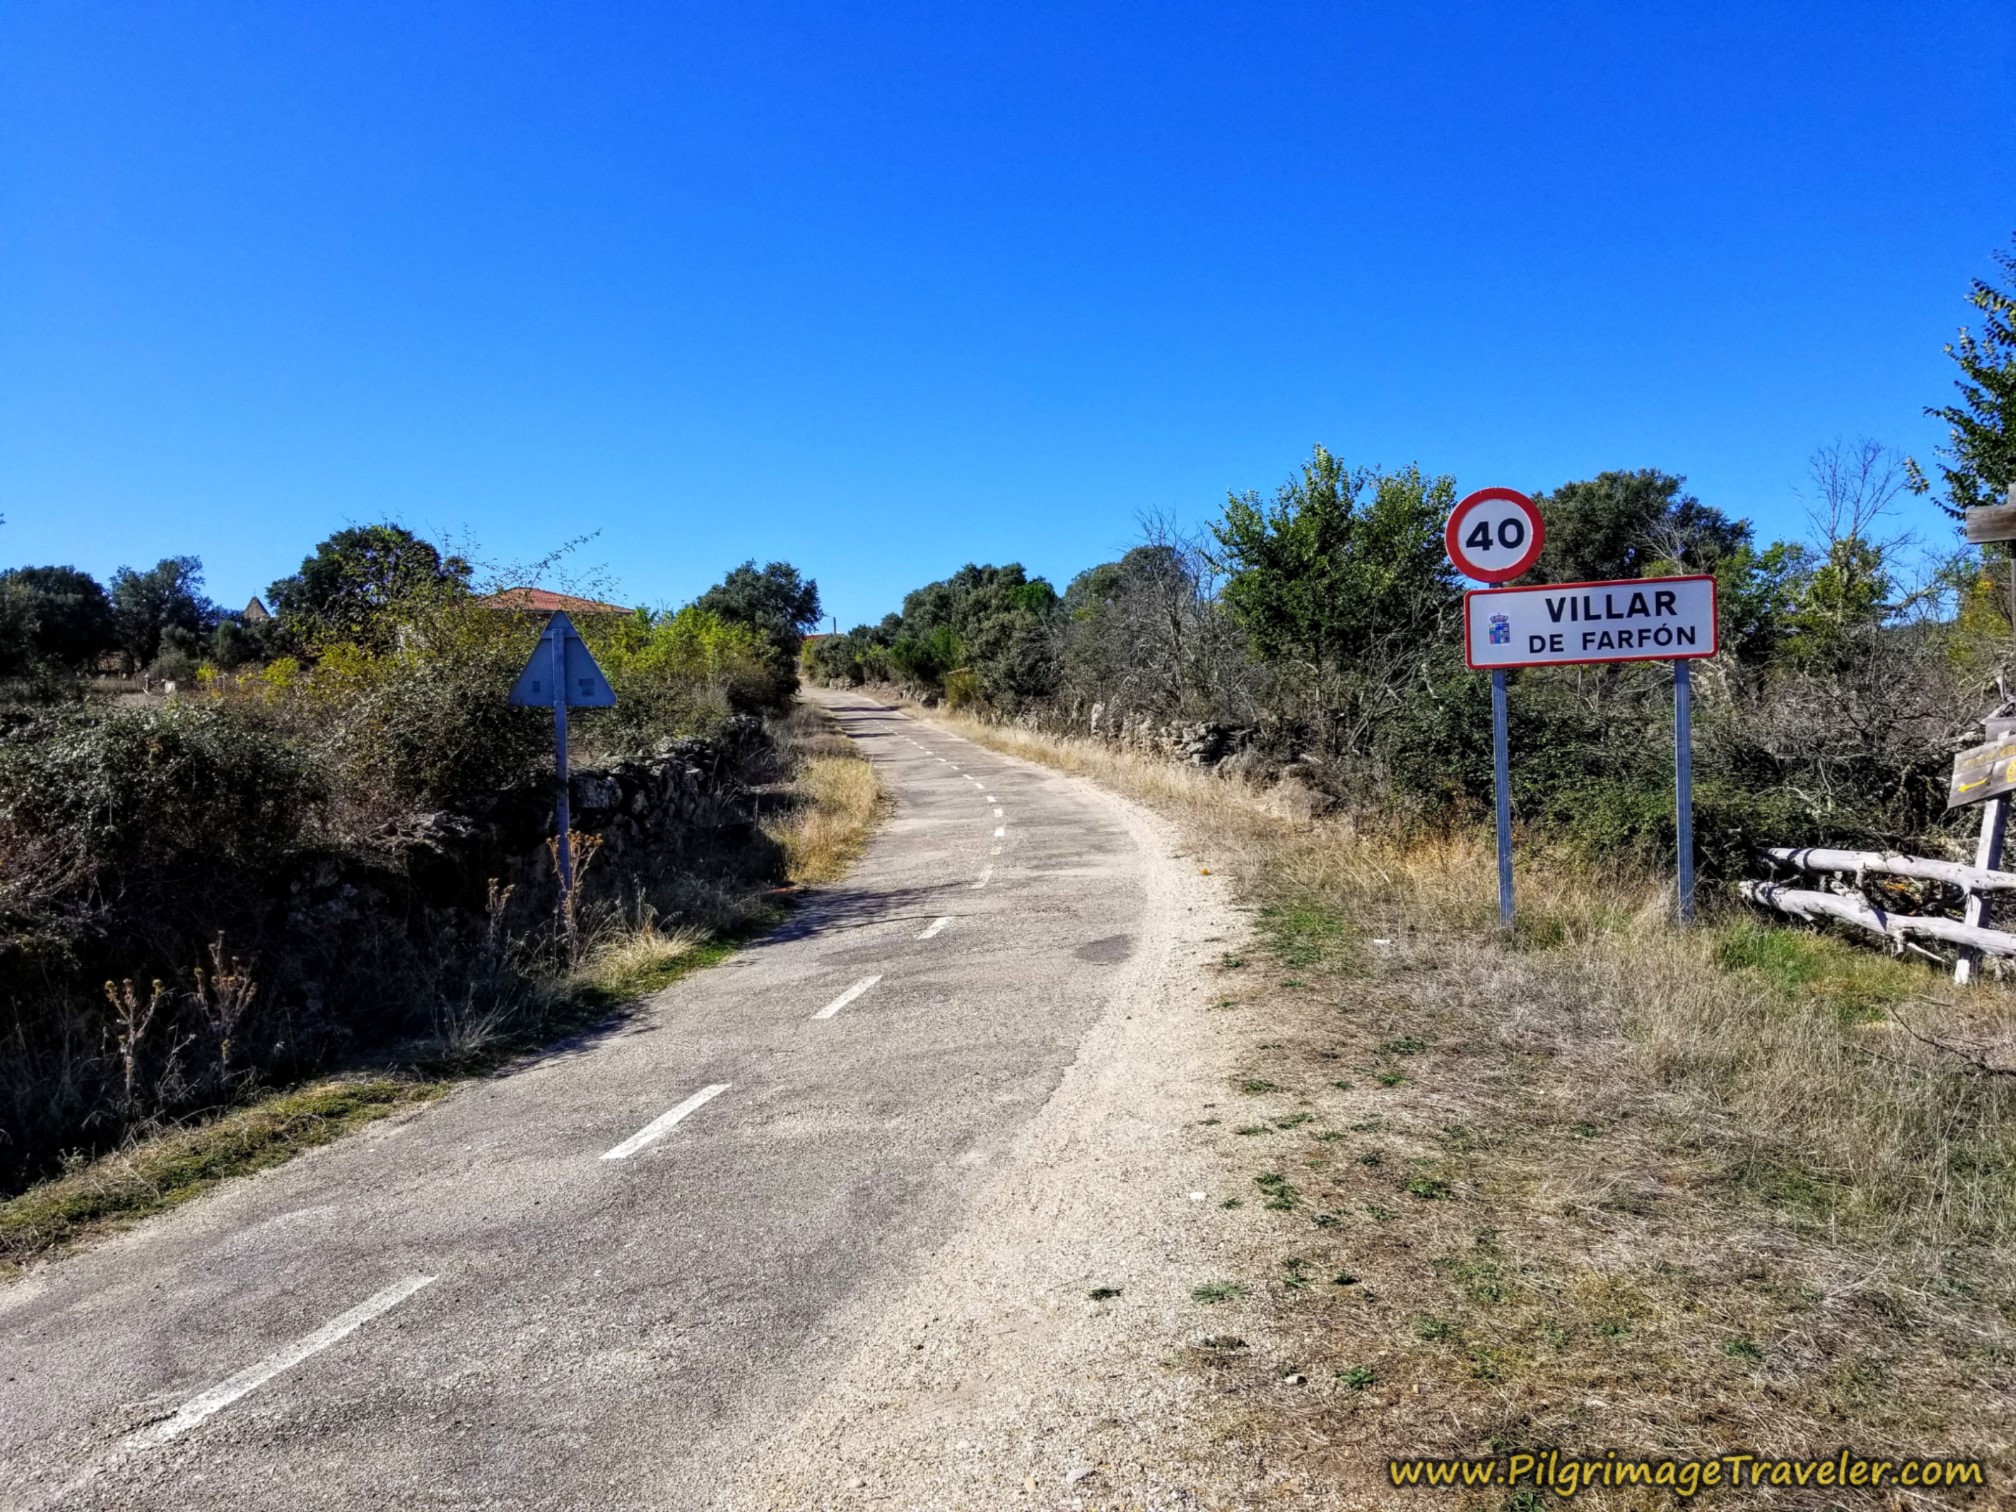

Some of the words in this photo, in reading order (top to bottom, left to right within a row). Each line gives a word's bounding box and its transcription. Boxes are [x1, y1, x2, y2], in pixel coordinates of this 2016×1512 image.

[1466, 518, 1525, 551] 40
[1545, 591, 1677, 623] VILLAR
[1529, 634, 1565, 654] DE
[1582, 623, 1696, 651] FARFÓN
